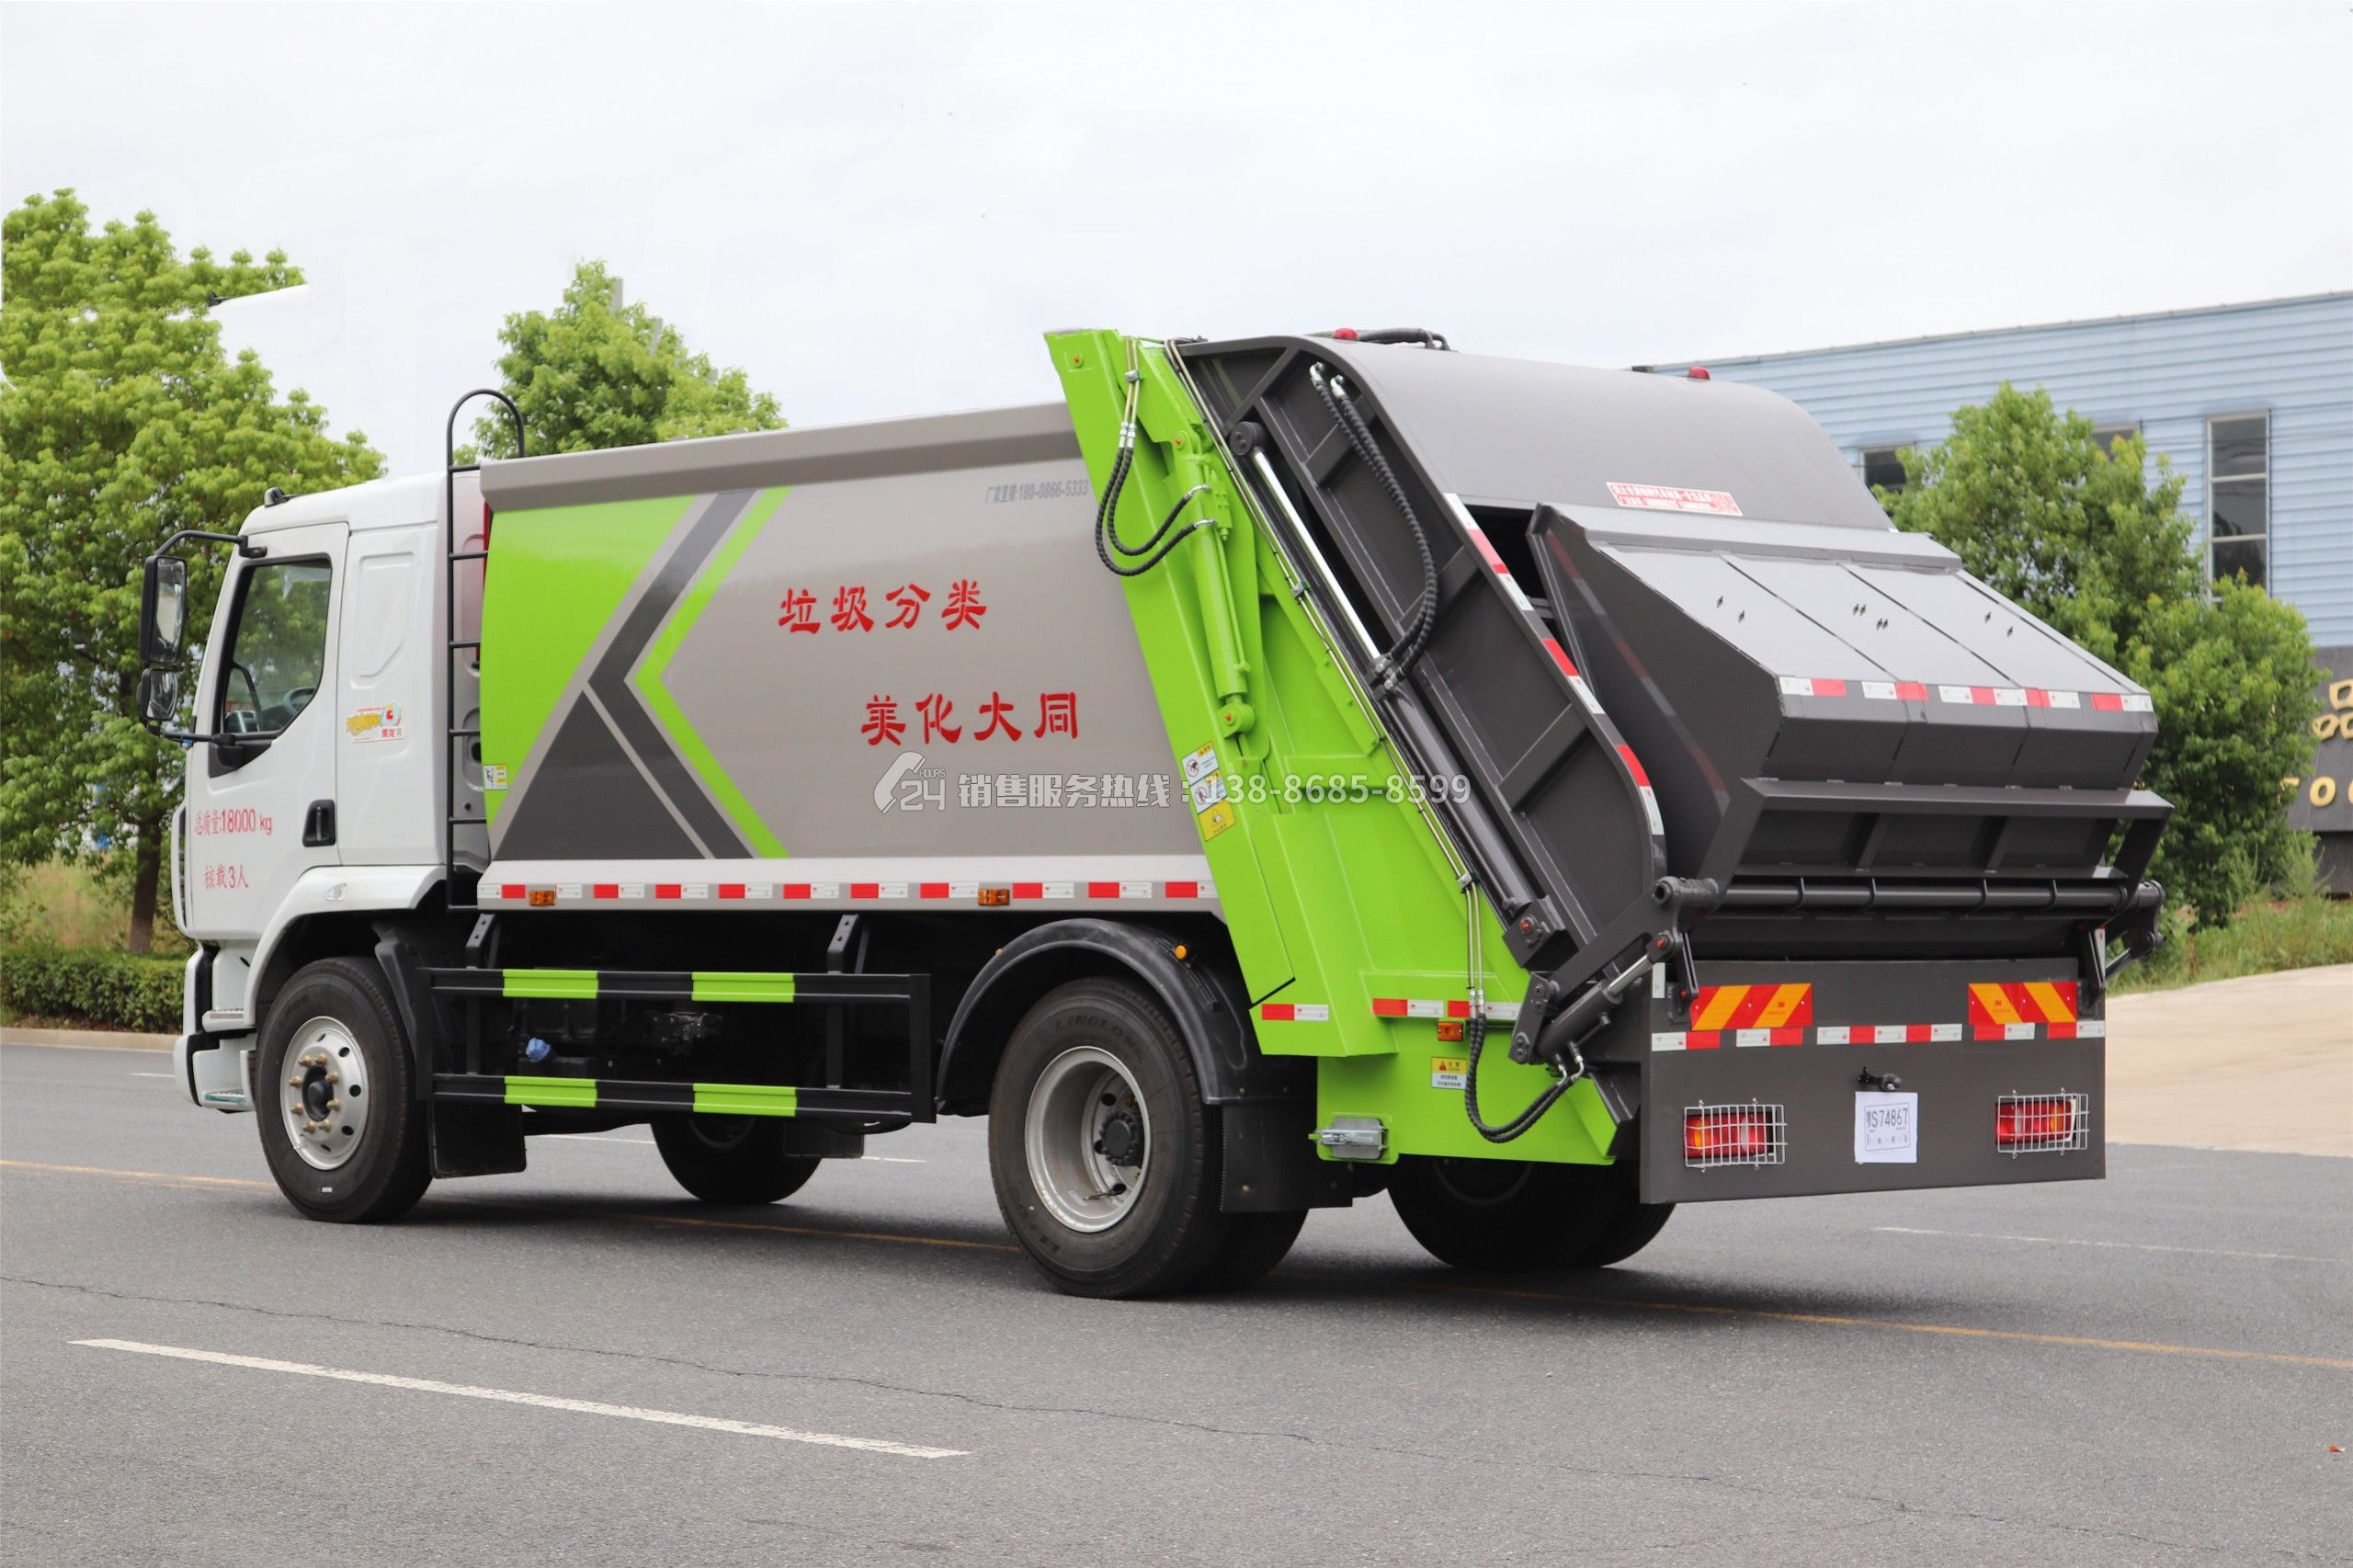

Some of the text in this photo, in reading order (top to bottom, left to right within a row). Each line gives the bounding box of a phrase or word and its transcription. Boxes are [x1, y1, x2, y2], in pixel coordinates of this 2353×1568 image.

[779, 579, 987, 634] 垃圾分类
[860, 691, 1078, 746] 美化大同
[259, 813, 272, 835] kg
